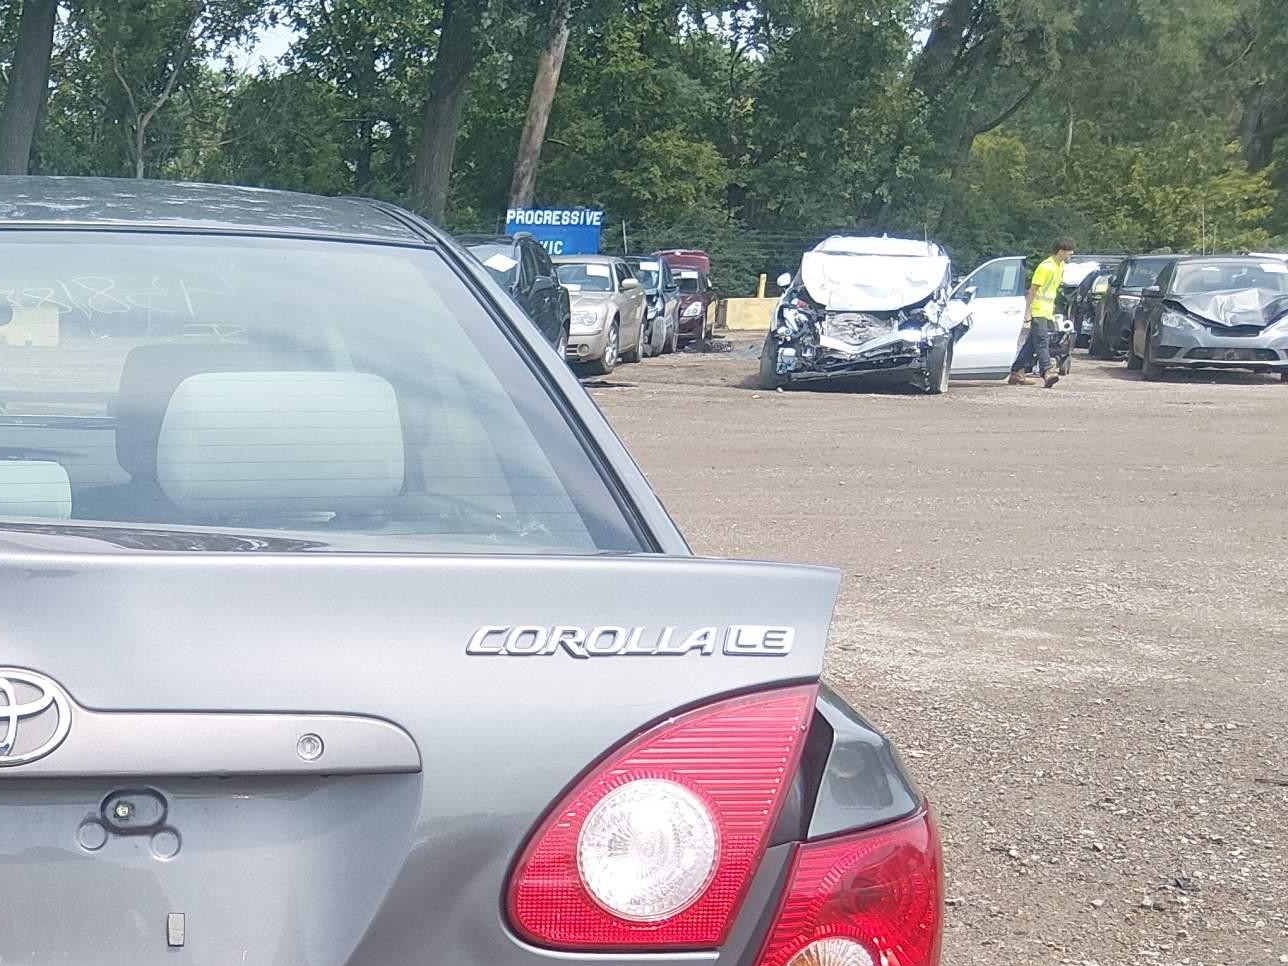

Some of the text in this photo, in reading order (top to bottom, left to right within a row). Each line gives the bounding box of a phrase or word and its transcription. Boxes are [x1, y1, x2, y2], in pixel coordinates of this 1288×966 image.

[506, 209, 603, 226] PROGRESSIVE
[465, 624, 796, 659] COROLLA LE
